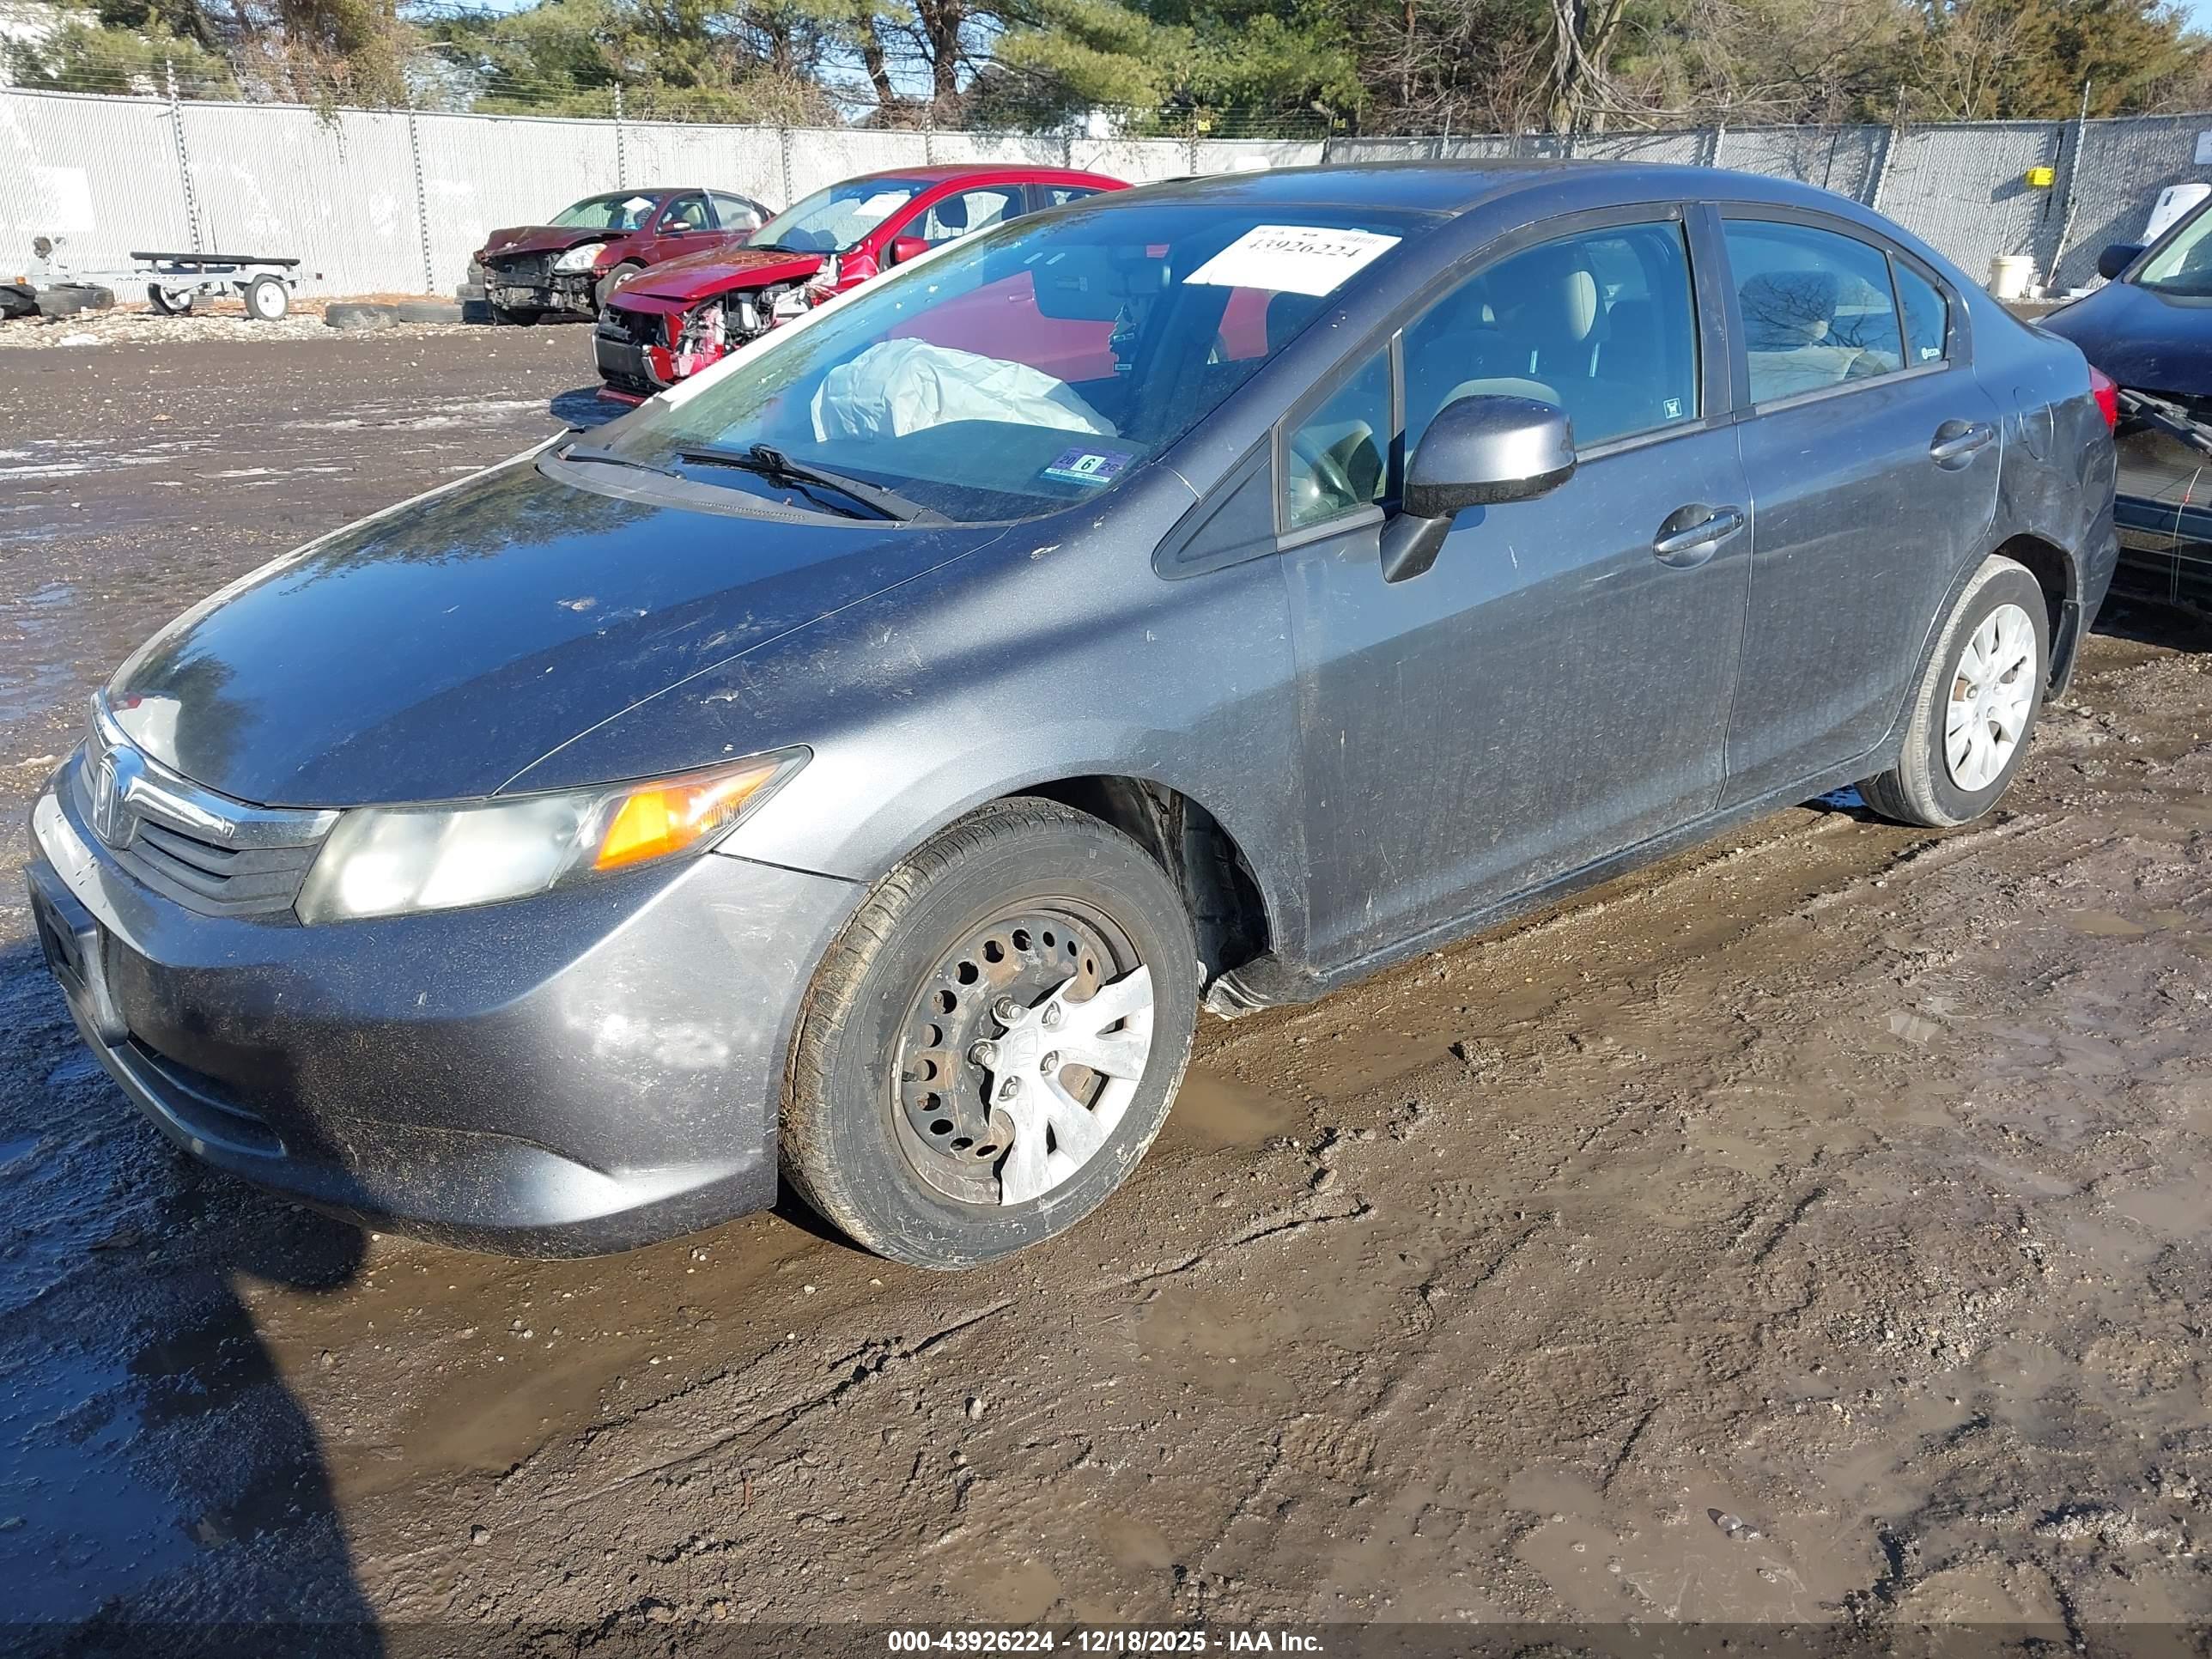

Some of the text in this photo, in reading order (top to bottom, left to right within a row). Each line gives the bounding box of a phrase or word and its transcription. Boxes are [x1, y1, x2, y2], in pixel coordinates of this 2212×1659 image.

[1248, 239, 1363, 258] 43926224
[1059, 455, 1120, 472] 20 6 26
